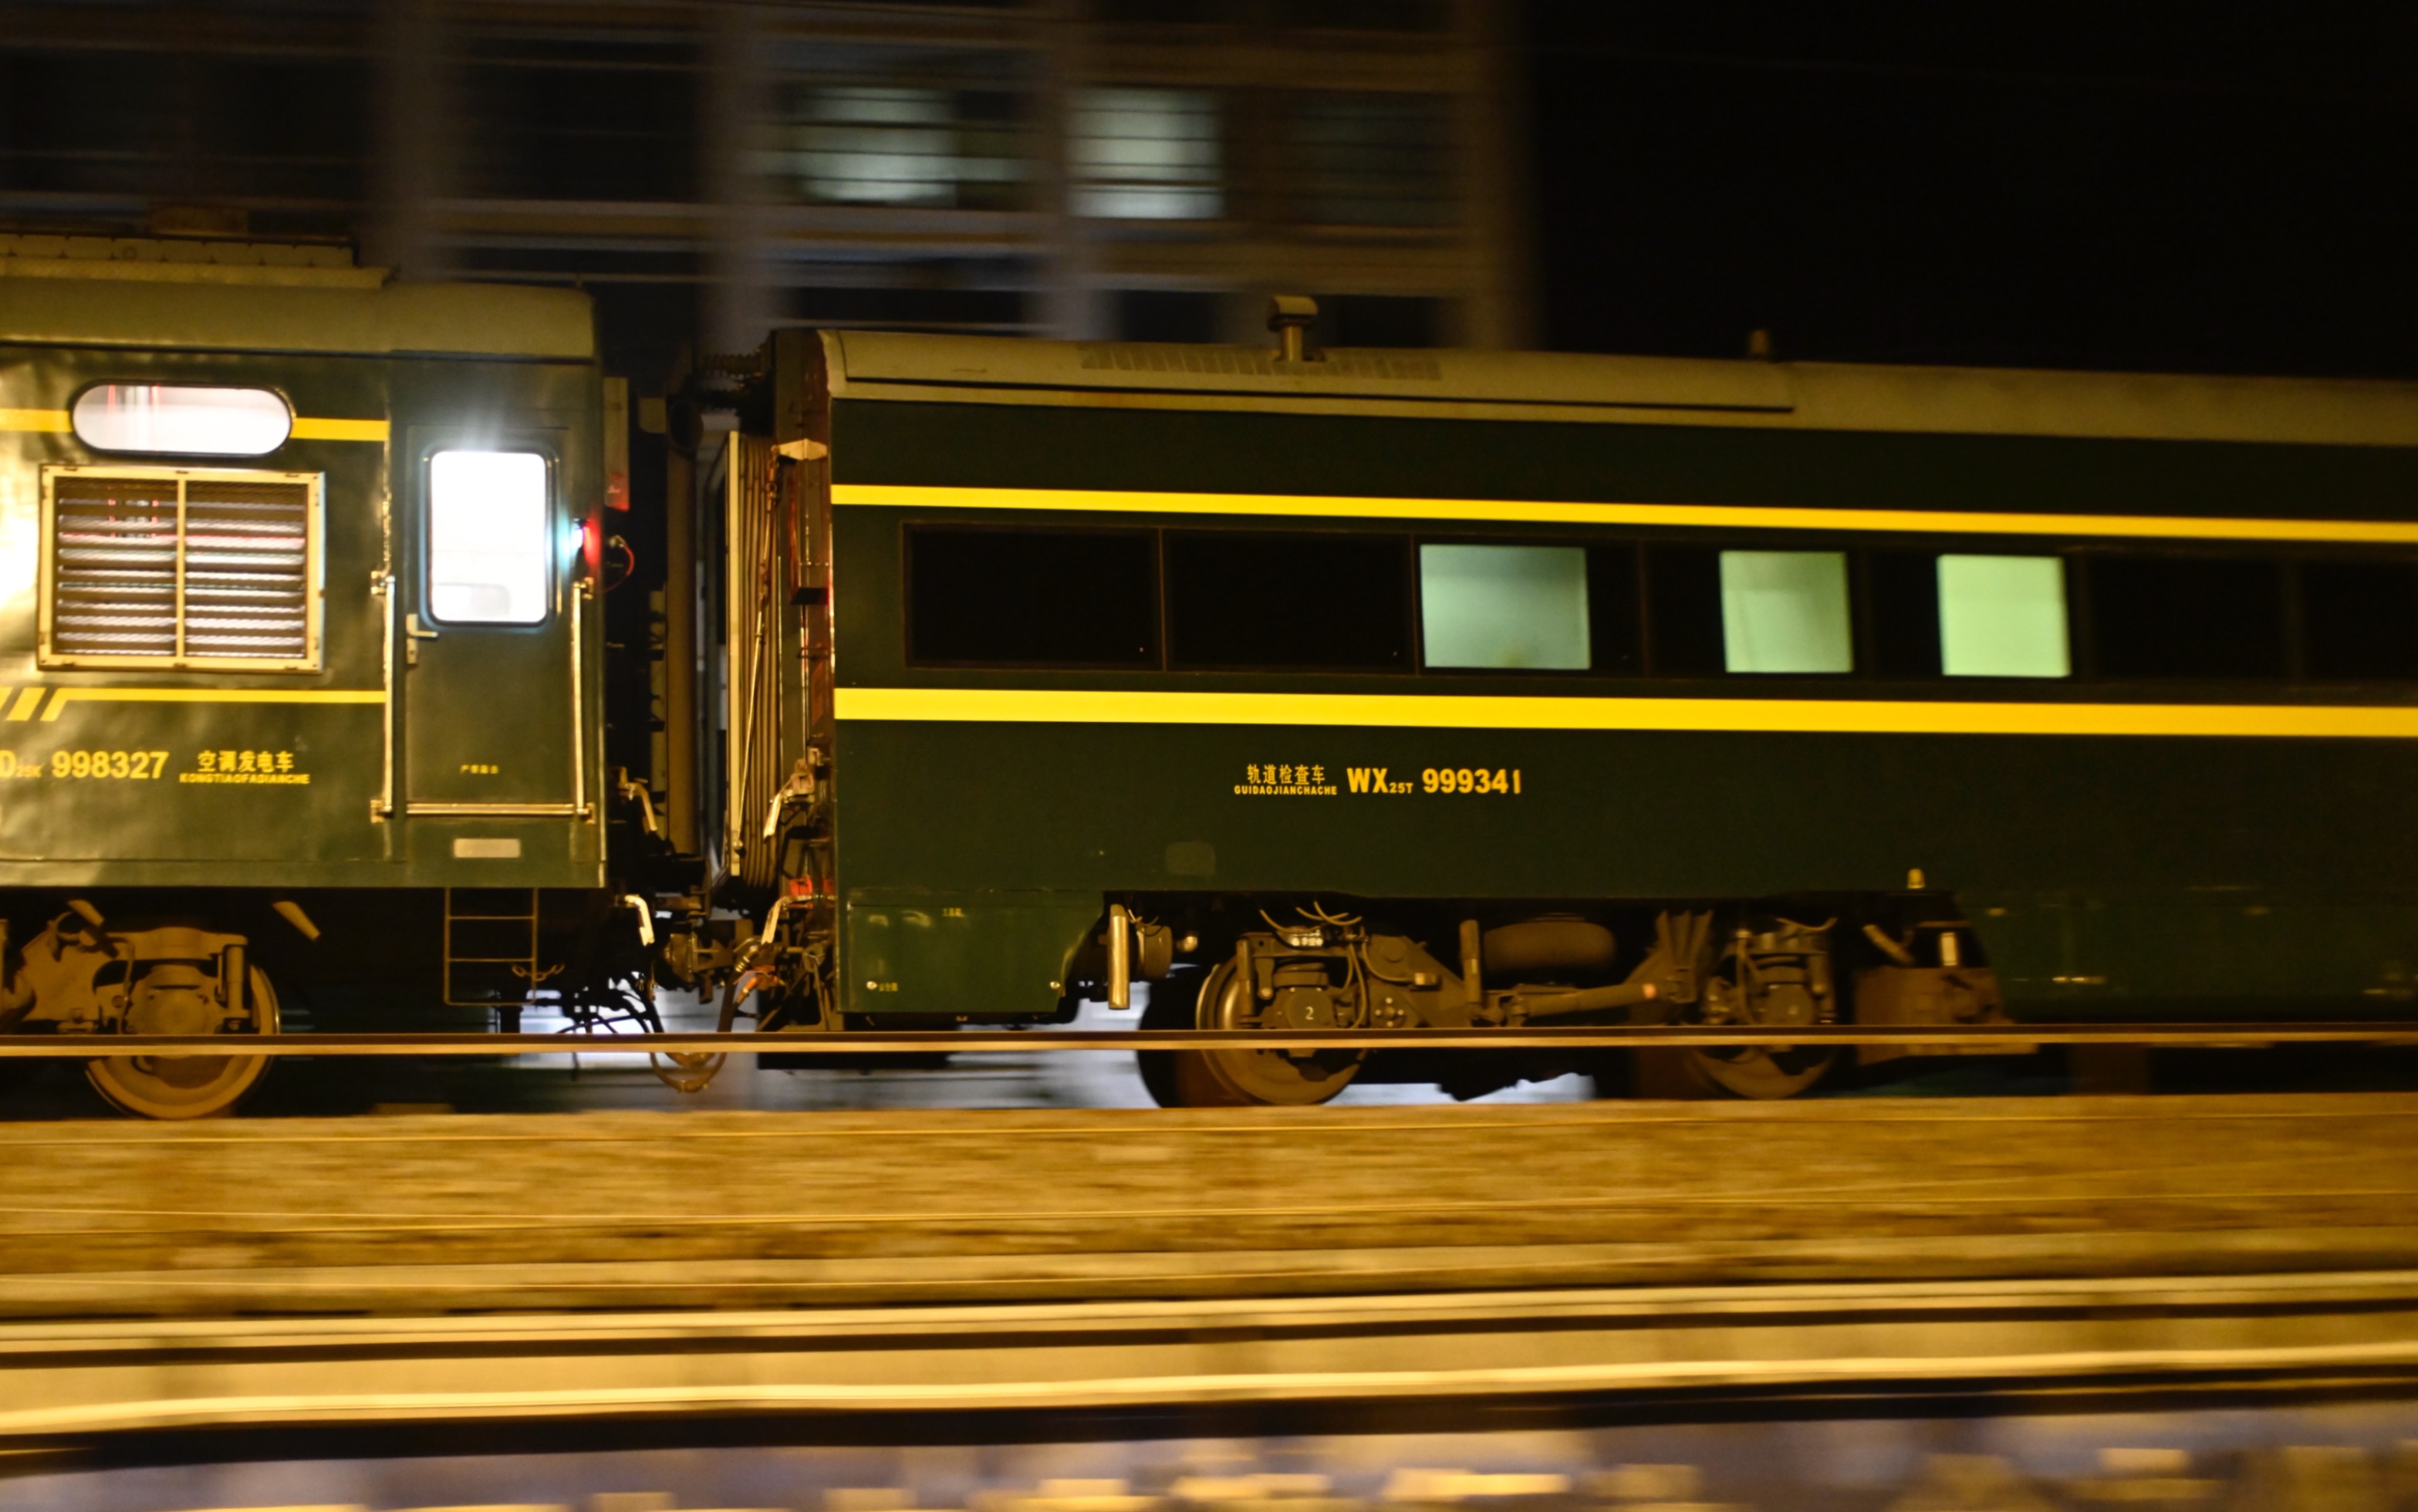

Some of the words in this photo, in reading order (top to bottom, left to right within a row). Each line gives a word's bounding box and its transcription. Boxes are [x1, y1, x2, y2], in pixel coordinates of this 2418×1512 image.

[52, 750, 170, 779] 998327
[197, 750, 295, 773] 空调发电车
[1247, 763, 1326, 785] 轨道检查车
[1422, 768, 1521, 795] 999341
[1234, 785, 1338, 795] GUIDAOJIANCHACHE
[1305, 1006, 1314, 1021] 2
